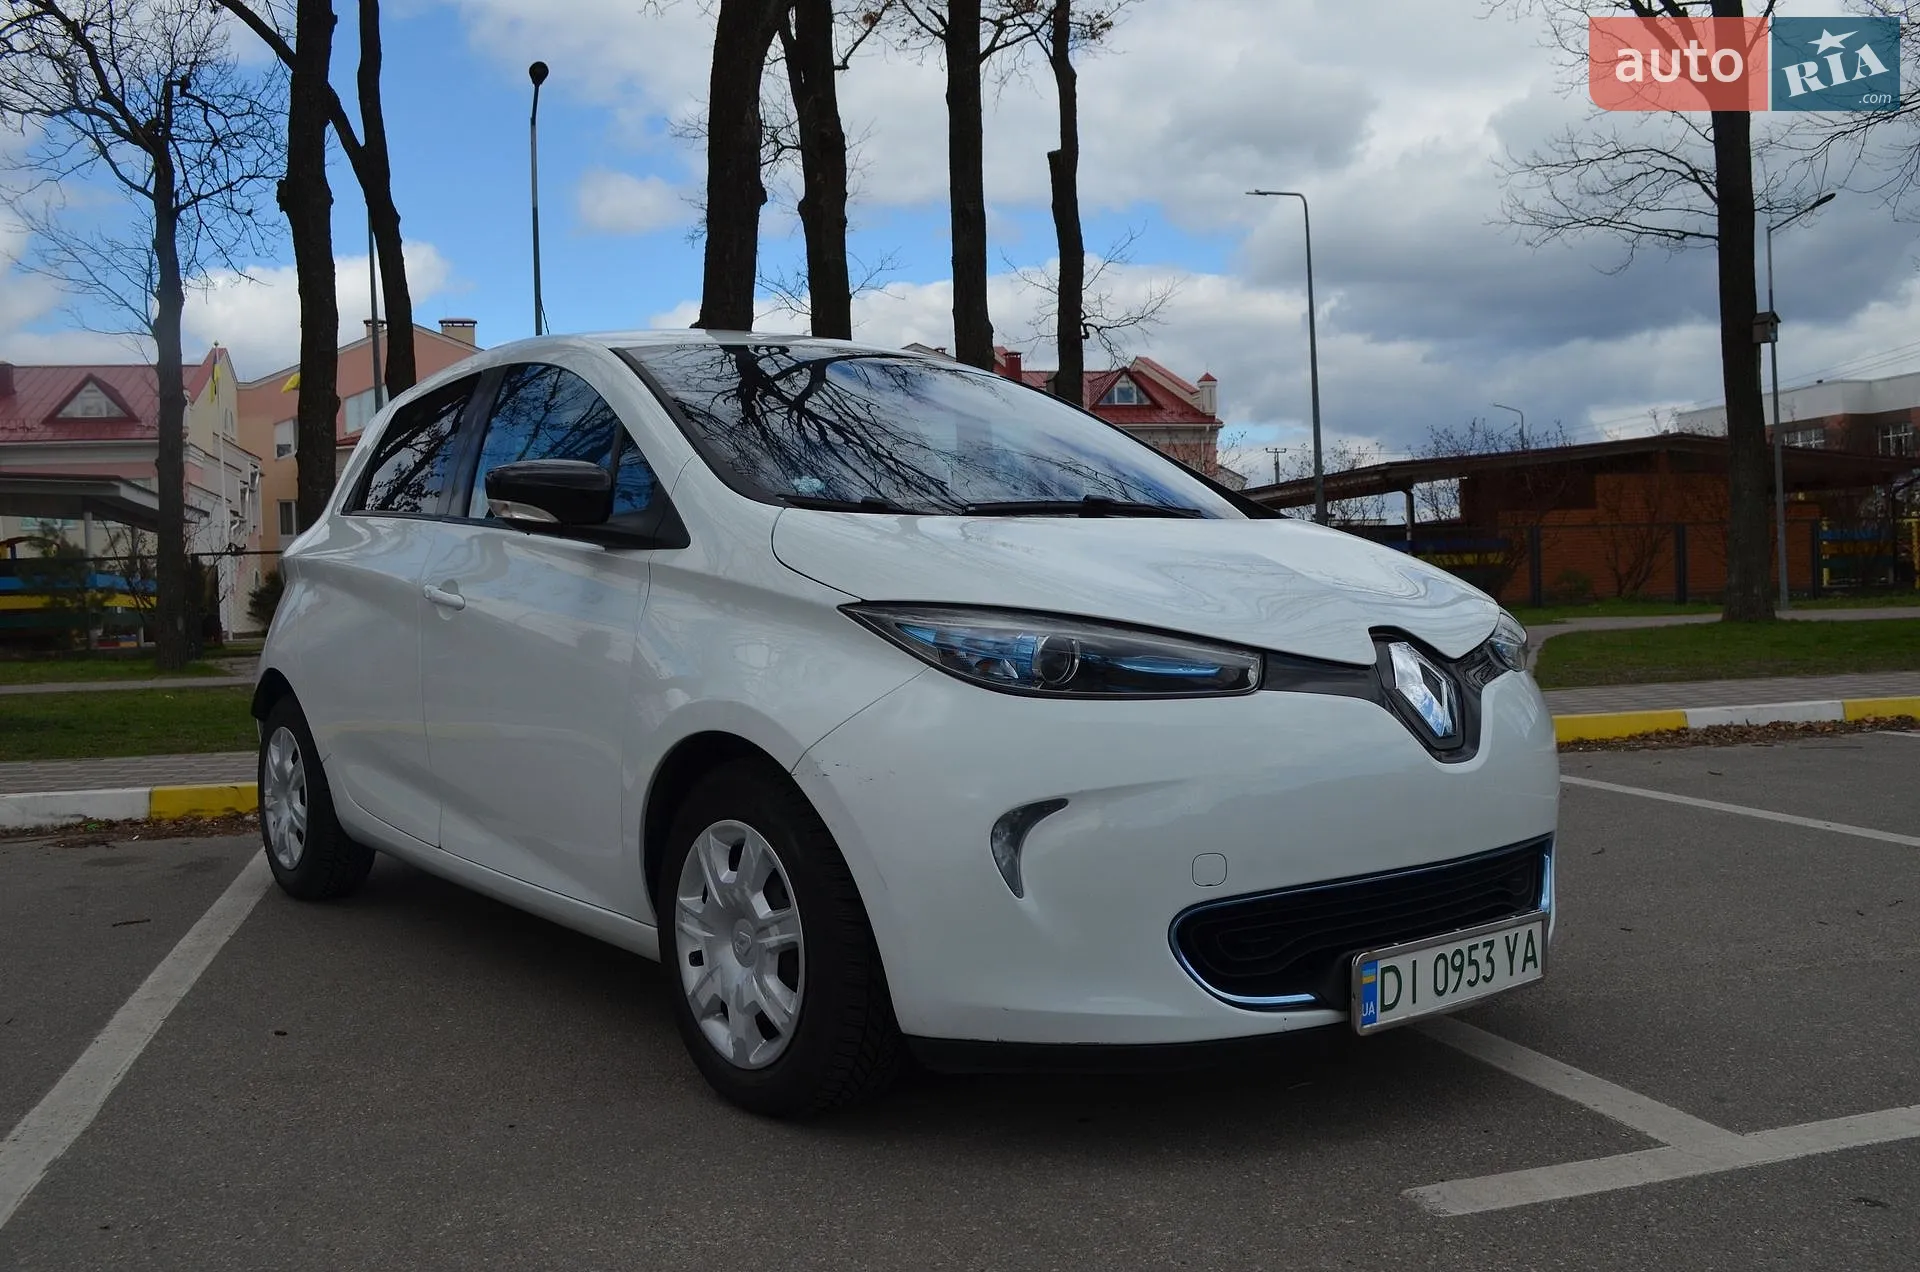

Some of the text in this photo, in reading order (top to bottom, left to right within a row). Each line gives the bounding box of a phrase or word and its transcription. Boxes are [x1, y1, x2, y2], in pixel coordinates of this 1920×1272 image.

[1380, 929, 1538, 1013] DI 0953 YA
[1362, 1003, 1375, 1017] UA
